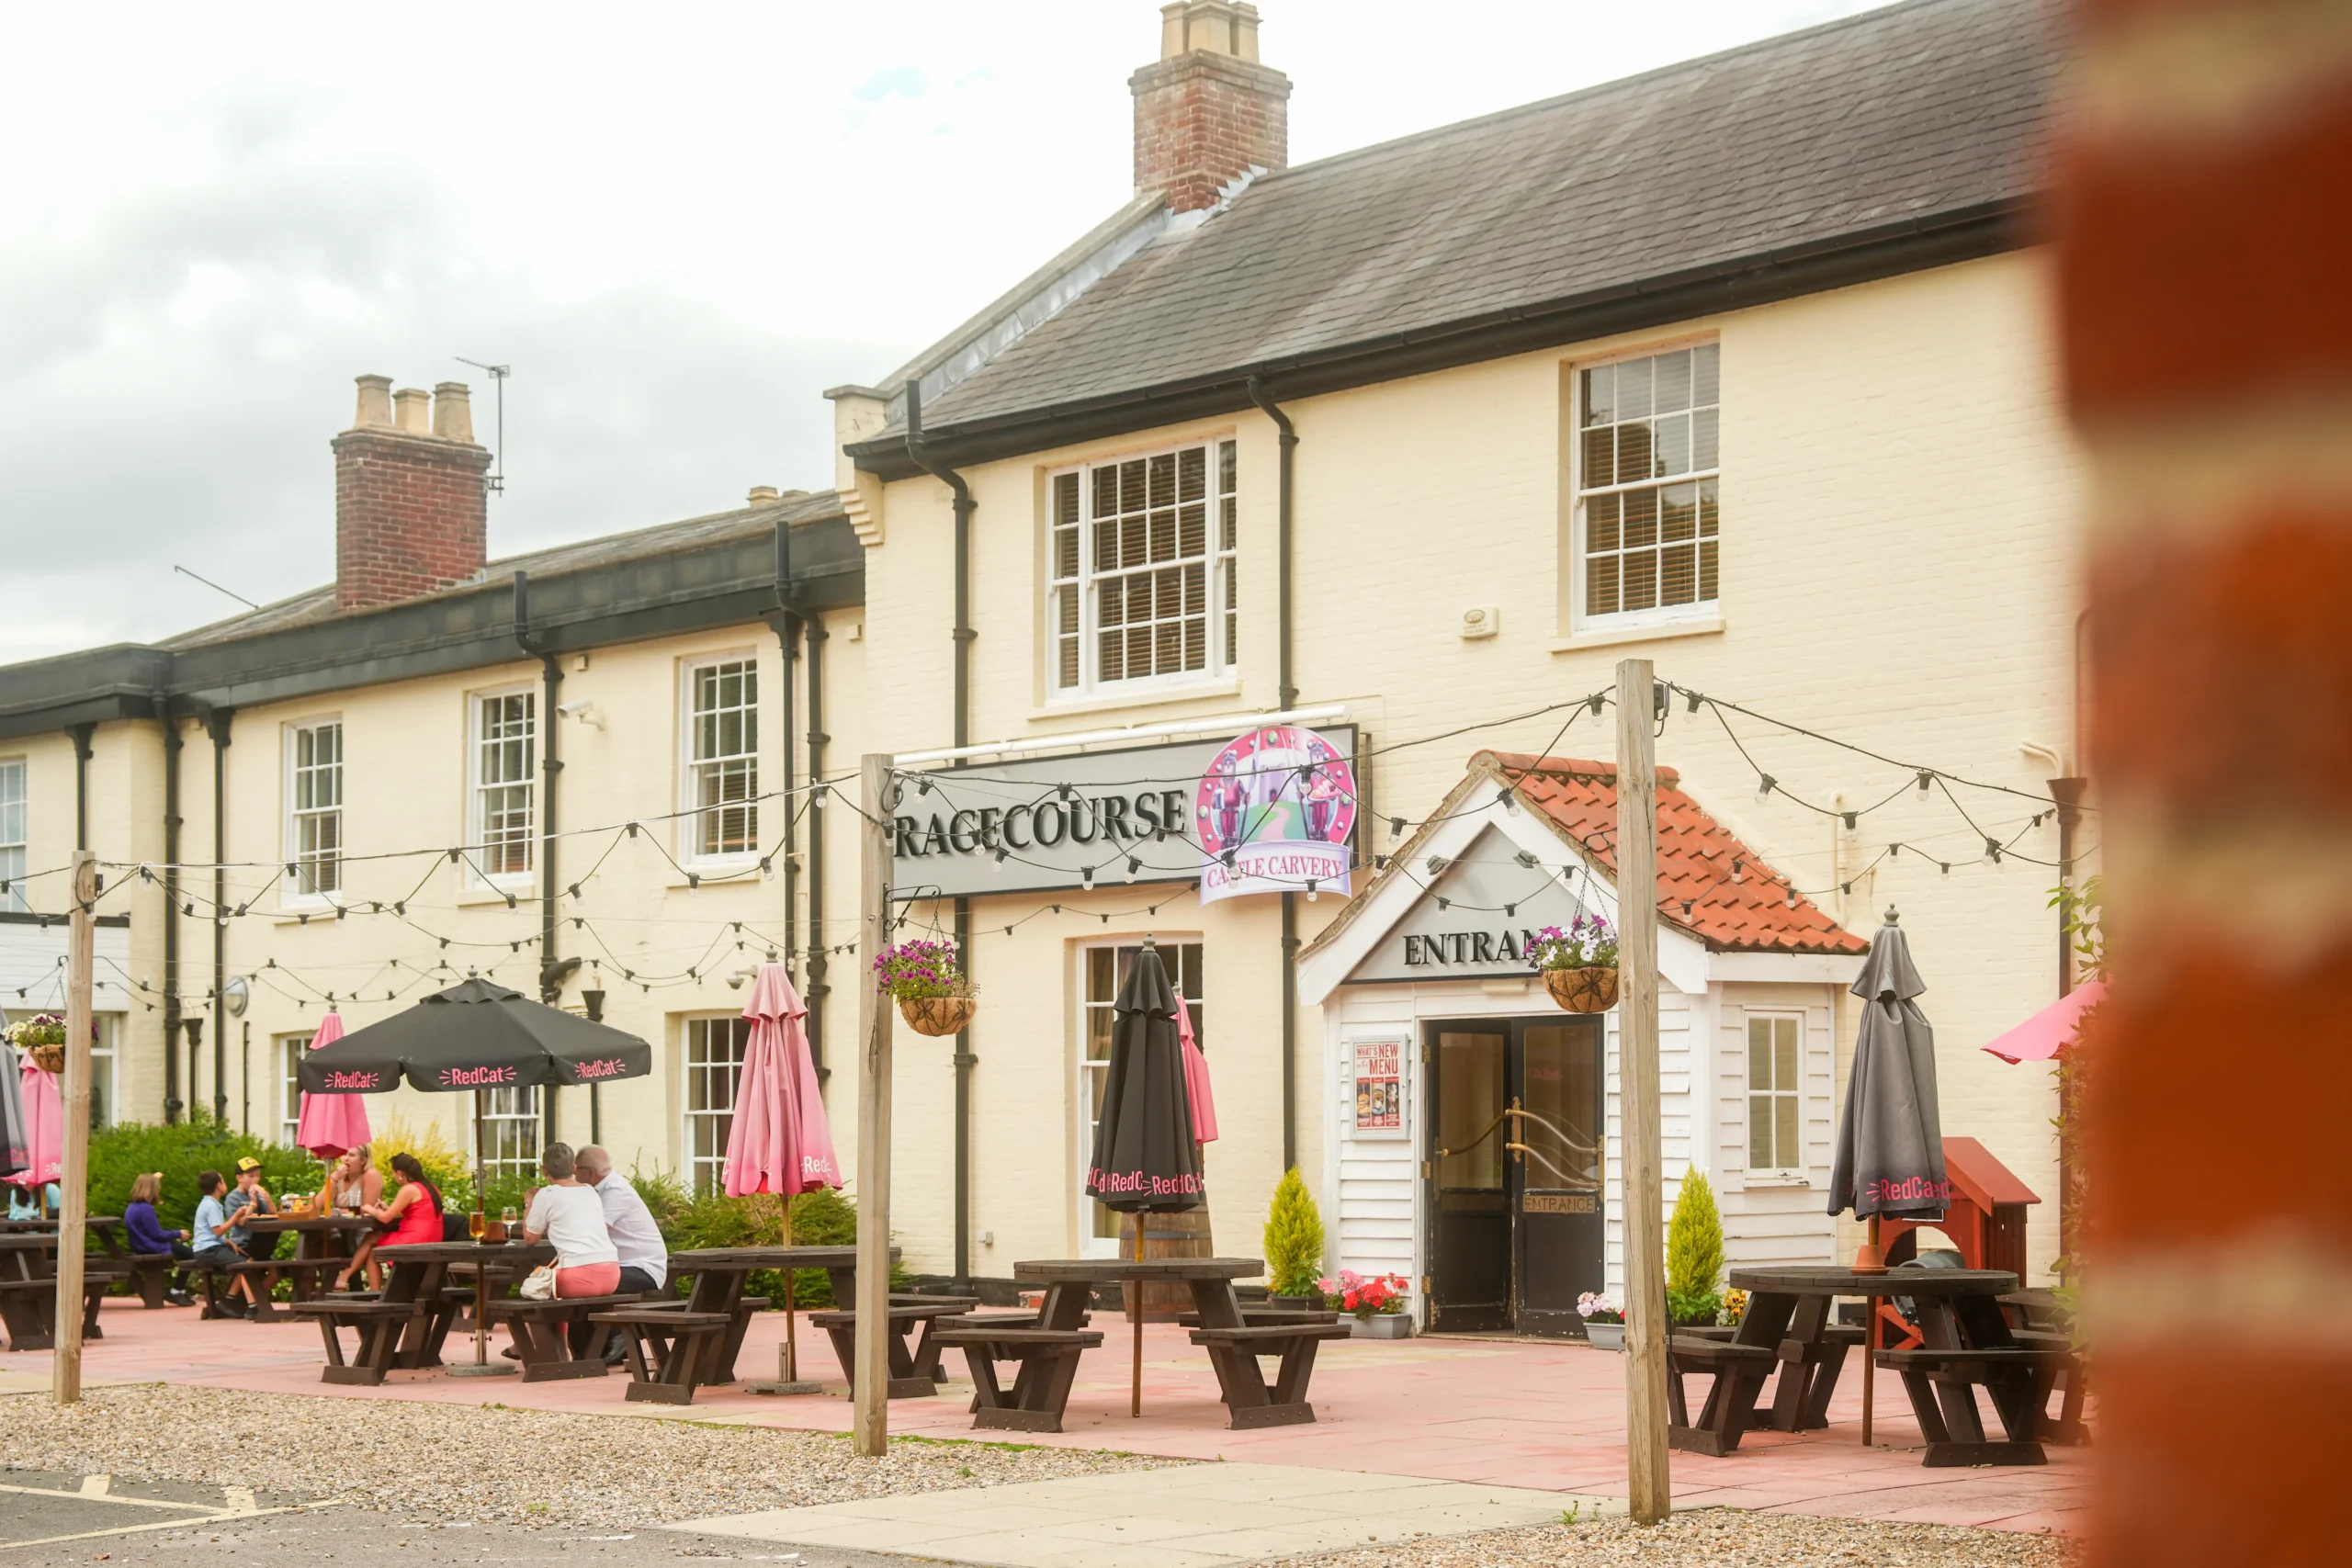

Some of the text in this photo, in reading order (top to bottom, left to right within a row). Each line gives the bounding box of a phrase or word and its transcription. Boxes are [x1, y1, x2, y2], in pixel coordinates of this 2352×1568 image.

[894, 789, 1185, 857] RACECOURSE
[1207, 855, 1342, 888] CATLE CARVERY
[1378, 1043, 1398, 1058] NEW
[451, 1066, 504, 1086] RedCat
[581, 1059, 618, 1078] RedCat
[1369, 1058, 1398, 1075] MENU
[334, 1070, 371, 1089] RedCat
[1524, 1197, 1594, 1212] ENTRANCE
